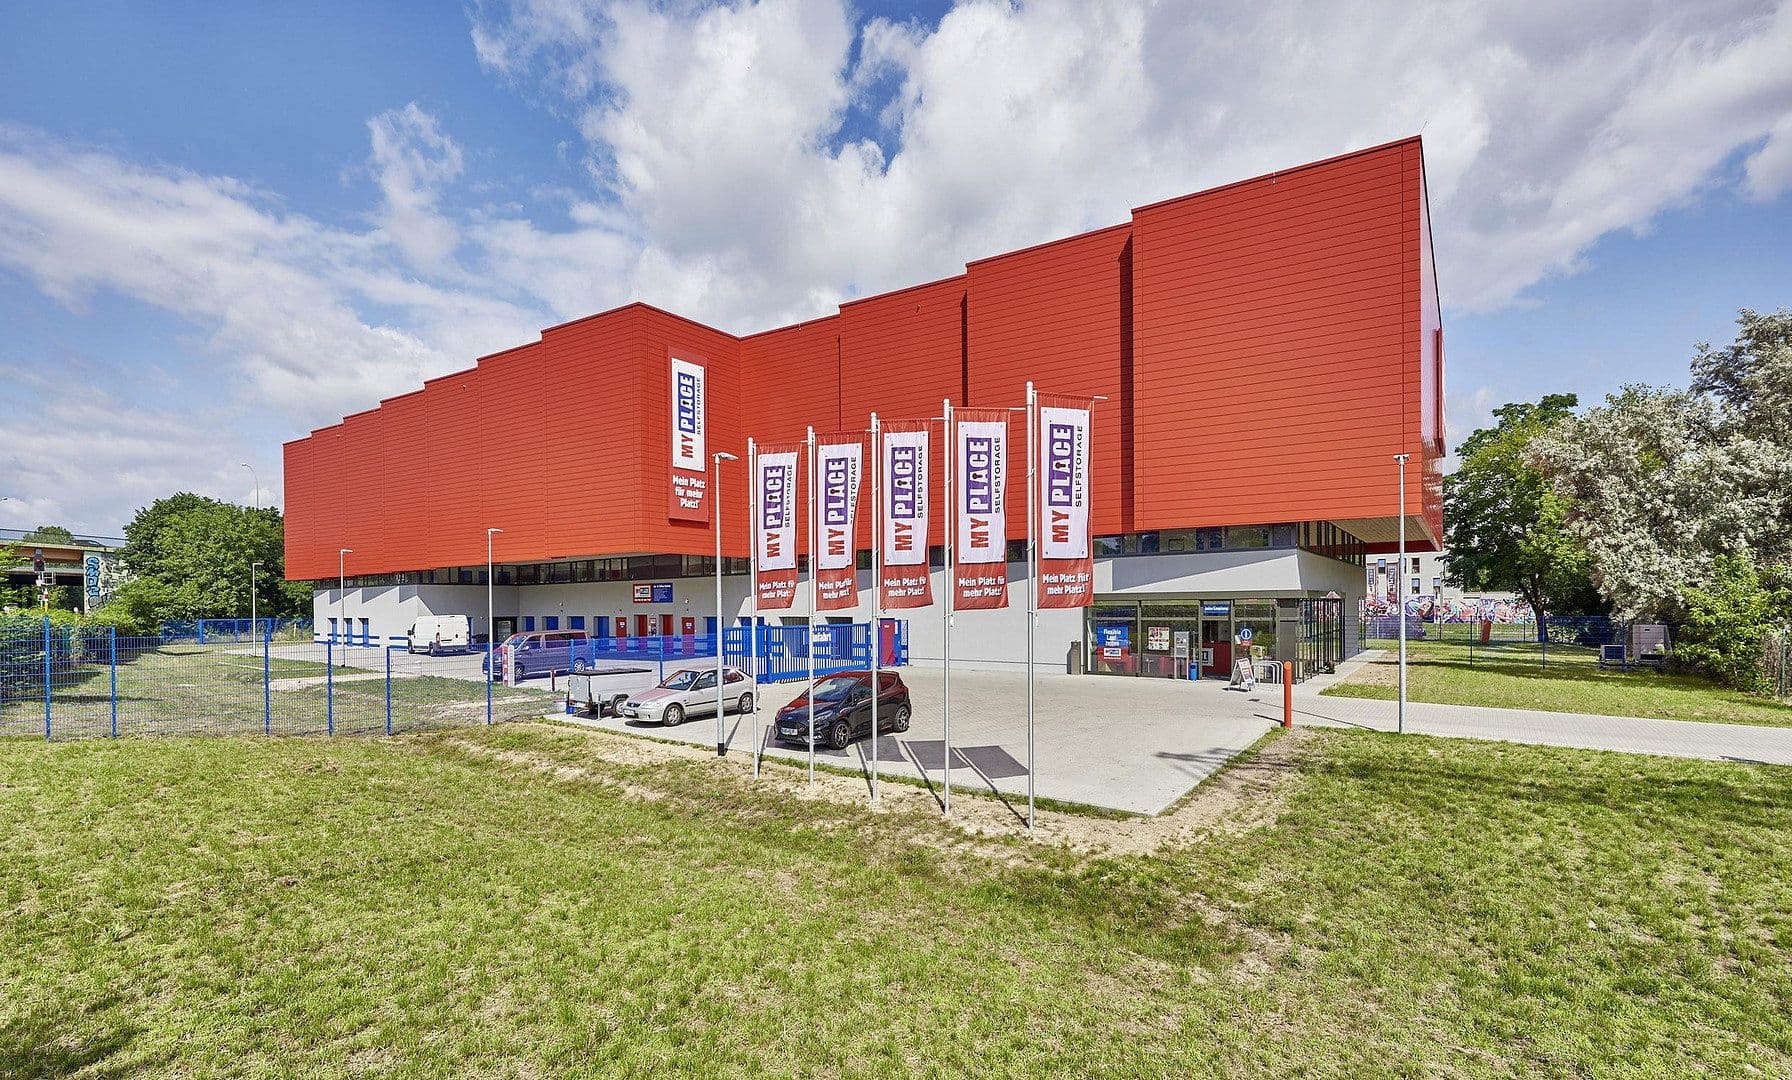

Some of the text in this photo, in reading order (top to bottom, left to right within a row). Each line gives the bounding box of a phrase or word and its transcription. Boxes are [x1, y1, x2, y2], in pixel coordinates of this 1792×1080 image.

[679, 373, 695, 459] MY PLACE
[1075, 425, 1083, 507] SELFSTORAGE
[672, 475, 706, 489] Mein Platz
[1051, 426, 1072, 543] MY PLACE
[674, 486, 703, 499] für mehr
[968, 440, 989, 548] MY PLACE
[893, 448, 913, 551] MY PLACE
[765, 467, 784, 558] MY PLACE
[827, 459, 846, 556] MY PLACE
[884, 577, 901, 588] Mein
[901, 576, 918, 587] Platz
[958, 577, 977, 588] Mein
[978, 576, 996, 586] Platz
[1042, 571, 1089, 584] Mein Platz für
[759, 581, 772, 591] Mein
[772, 580, 787, 590] Platz
[818, 581, 834, 590] Mein
[888, 587, 906, 597] mehr
[1047, 584, 1085, 595] mehr Platz!
[762, 590, 776, 599] mehr
[822, 591, 838, 599] mehr
[963, 587, 982, 598] mehr
